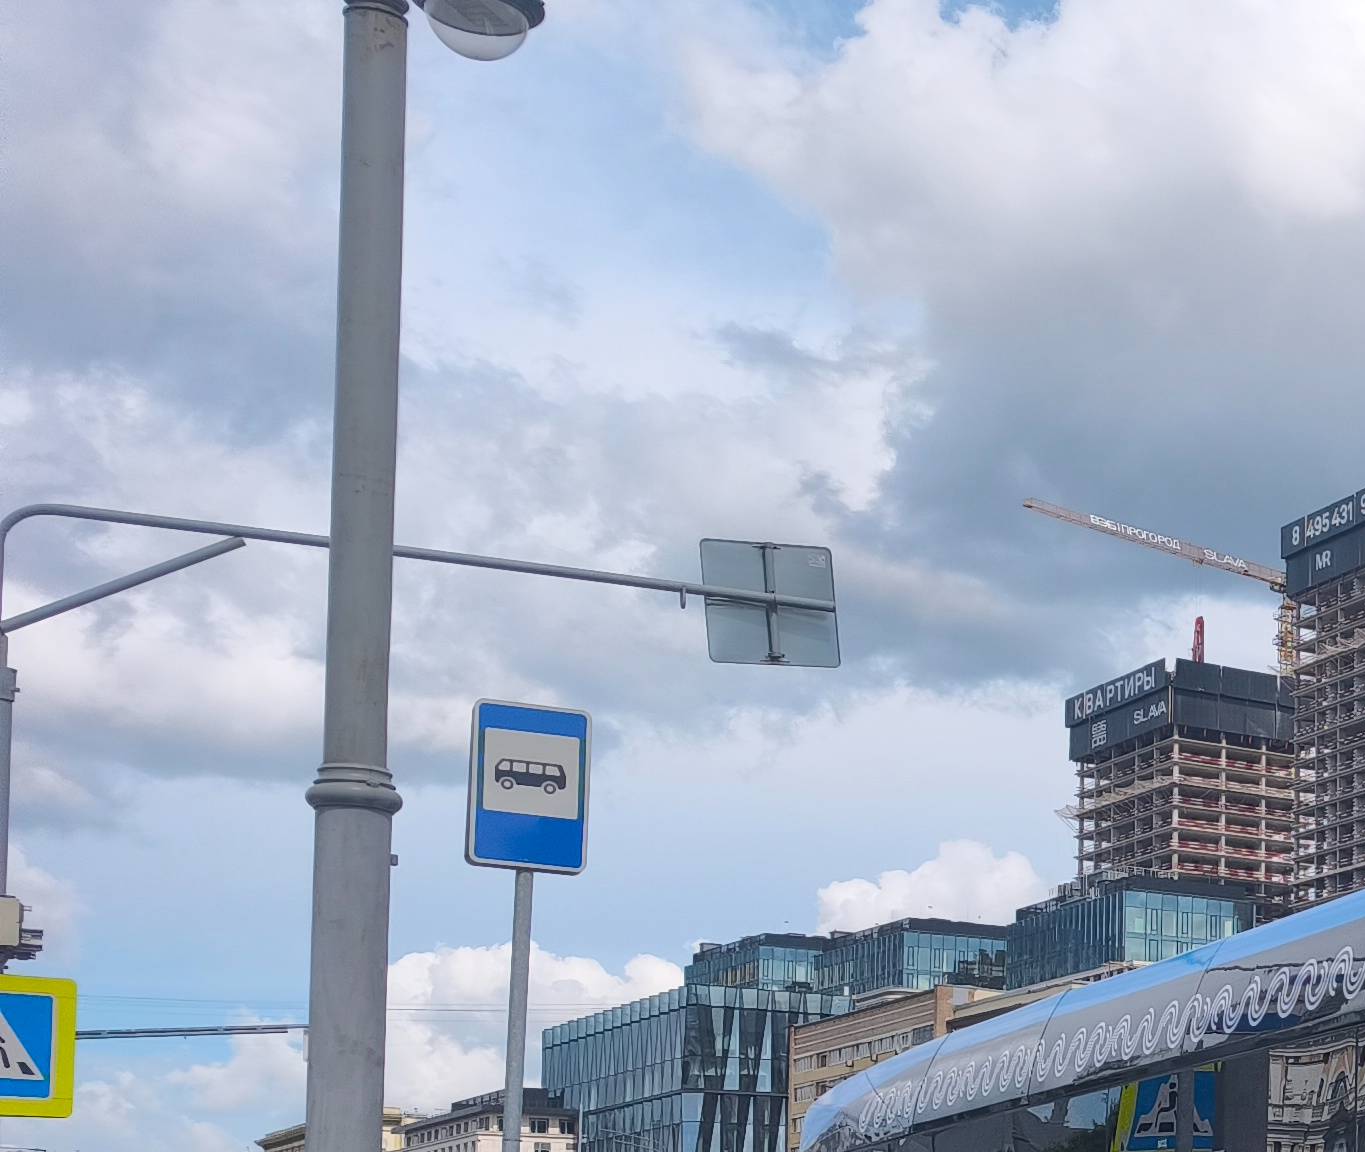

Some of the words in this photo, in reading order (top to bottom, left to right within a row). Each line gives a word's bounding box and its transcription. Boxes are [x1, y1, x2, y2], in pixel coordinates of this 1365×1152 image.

[1292, 525, 1300, 546] 8
[1306, 512, 1330, 539] 495
[1331, 501, 1353, 527] 431
[1204, 549, 1248, 570] SLAVA
[1315, 550, 1331, 571] MR
[1074, 666, 1156, 720] КВАРТИРЫ
[1133, 700, 1167, 725] SLAVA
